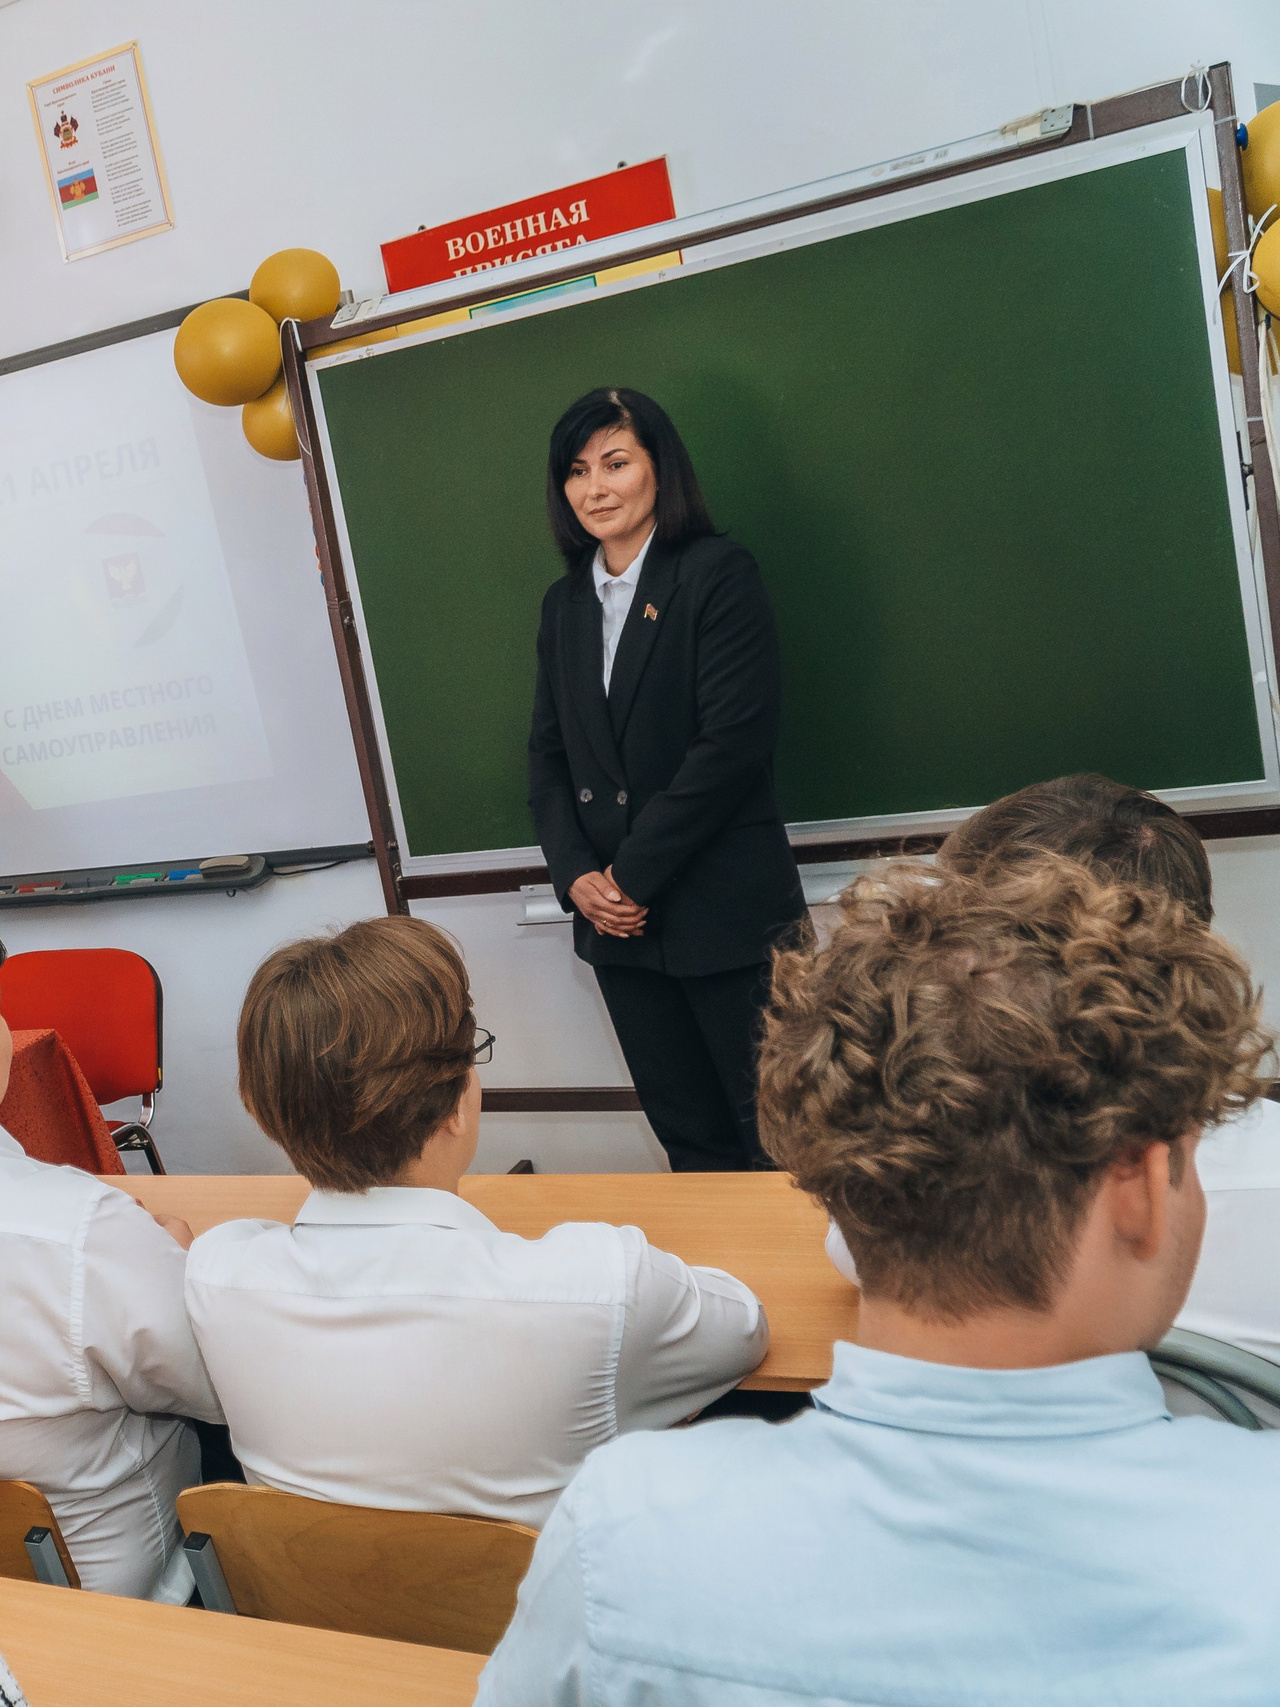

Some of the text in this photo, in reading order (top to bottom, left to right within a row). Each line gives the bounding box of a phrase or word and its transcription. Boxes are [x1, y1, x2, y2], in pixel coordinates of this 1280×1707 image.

[445, 199, 590, 261] ВОЕННАЯ
[30, 437, 161, 497] АПРЕЛЯ
[3, 674, 214, 731] С ДНЕМ МЕСТНОГО
[2, 712, 217, 767] САМОУПРАВЛЕНИЯ
